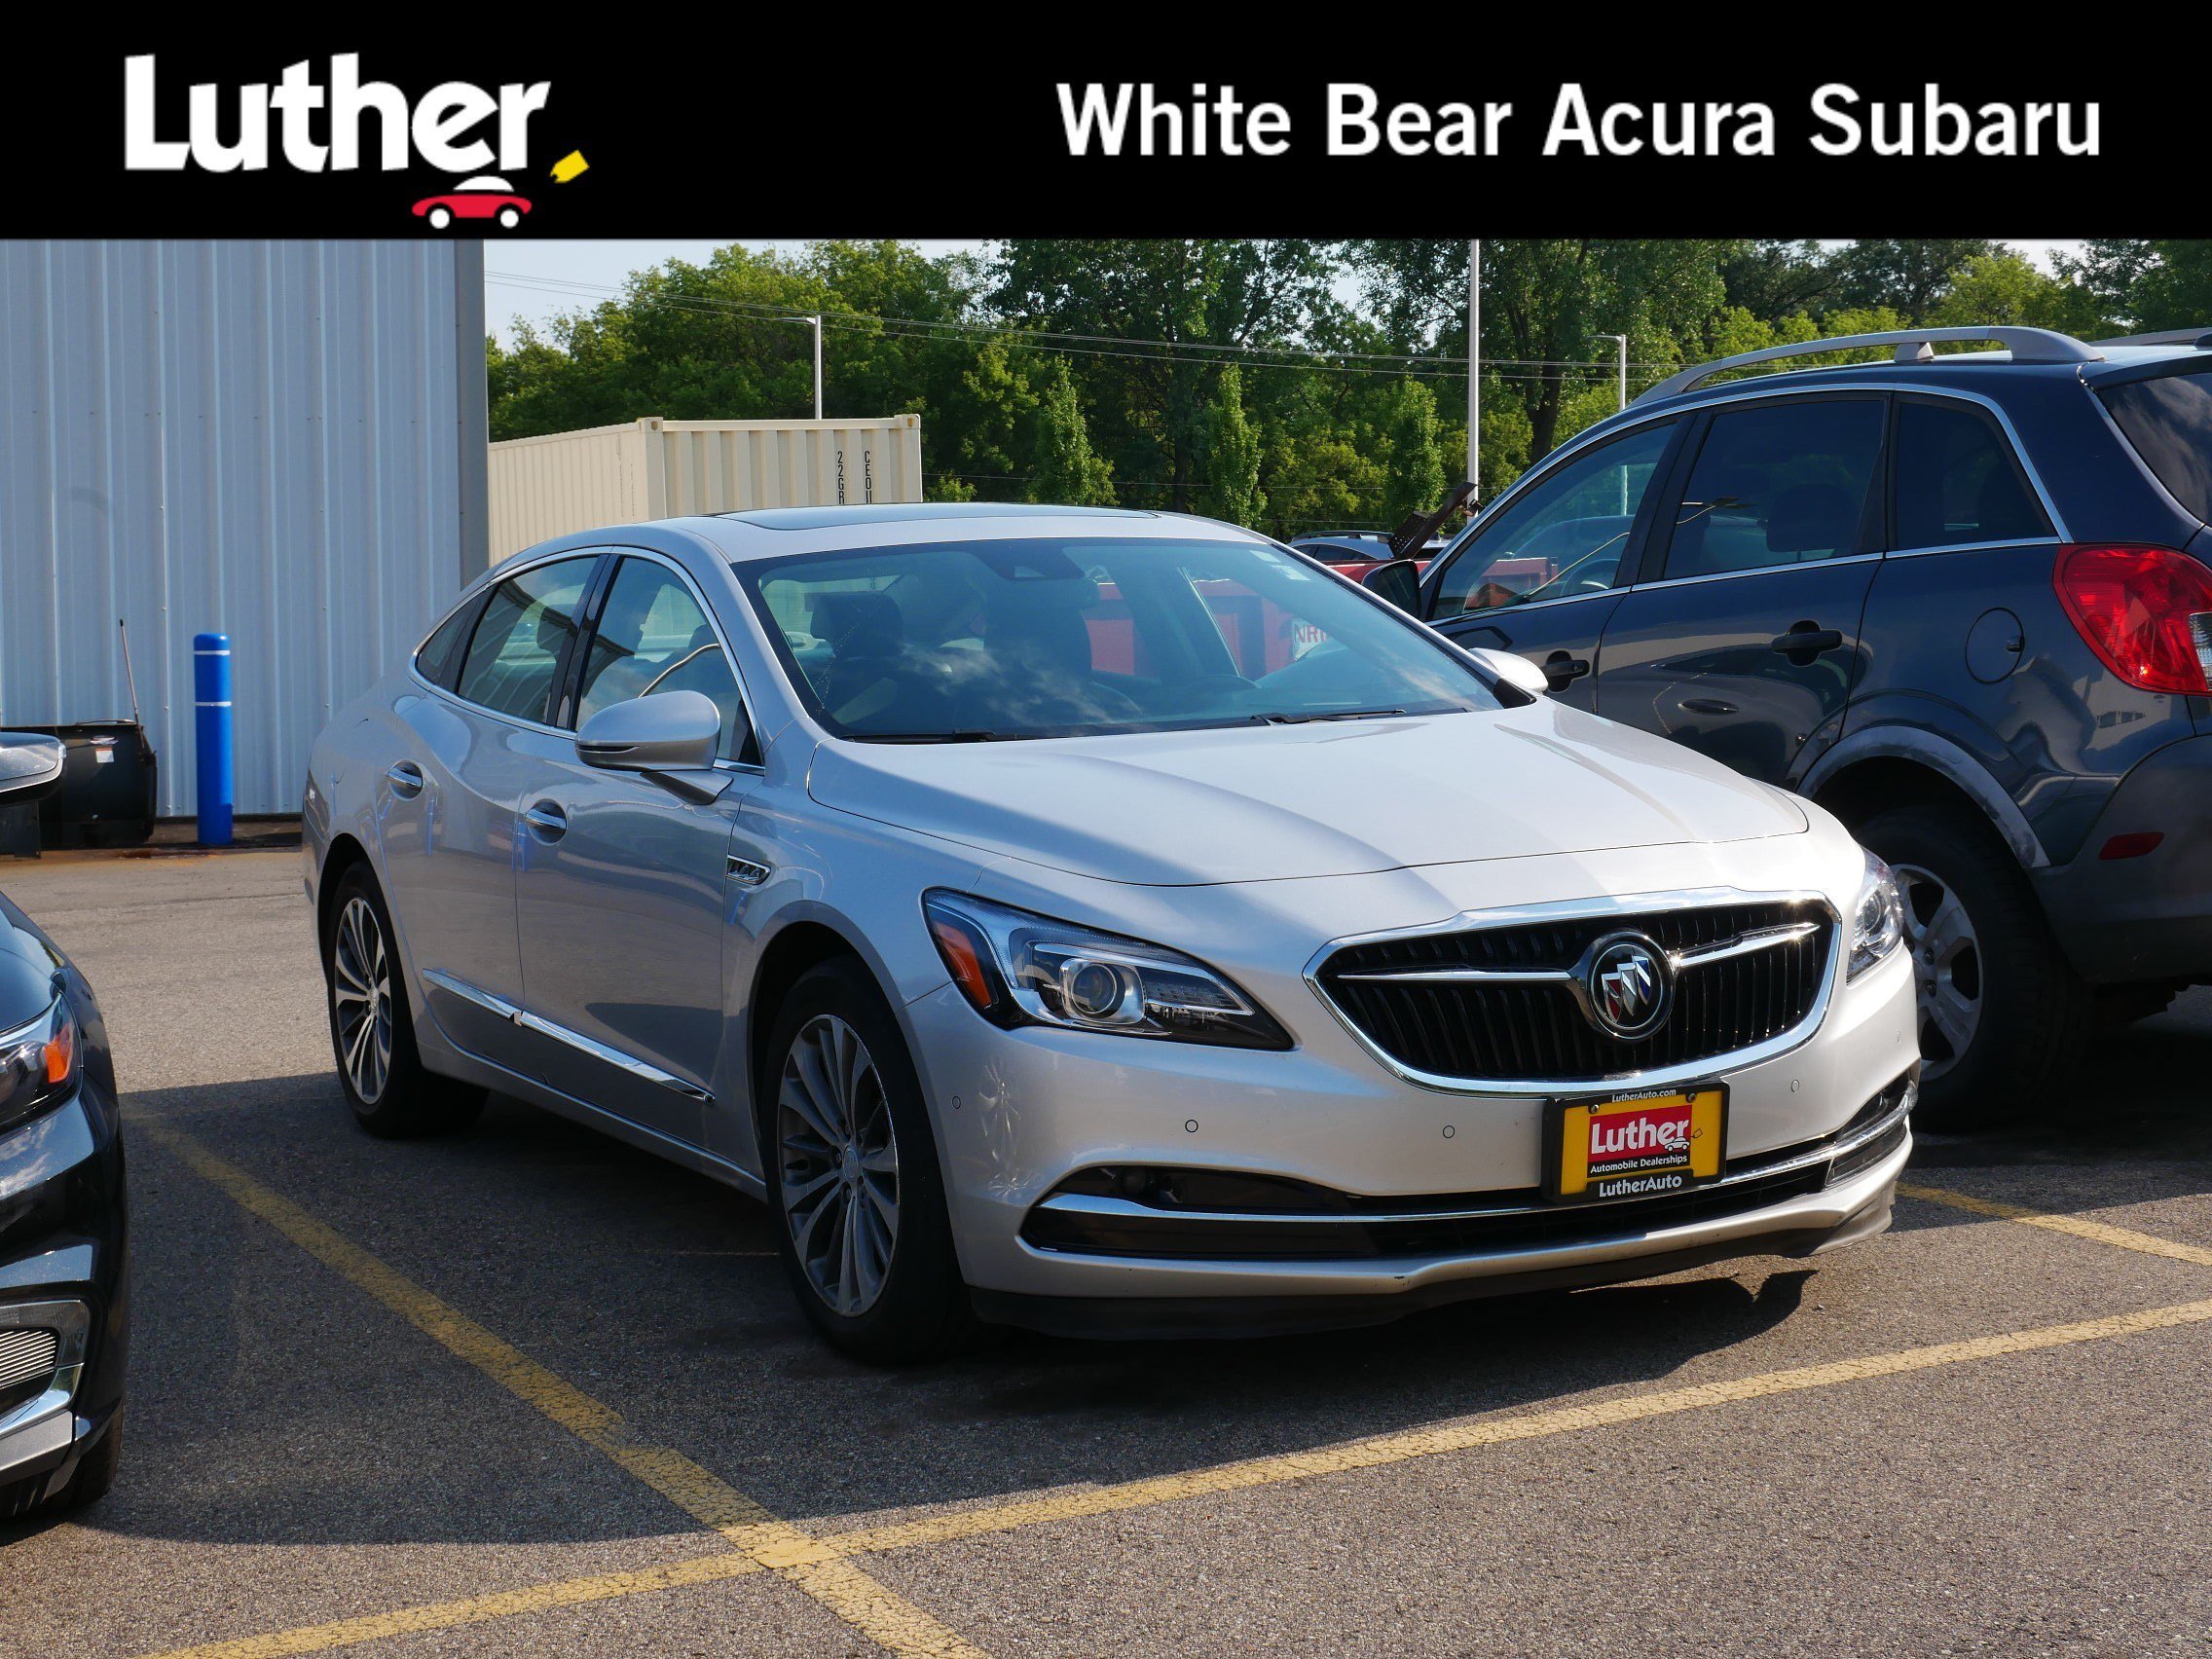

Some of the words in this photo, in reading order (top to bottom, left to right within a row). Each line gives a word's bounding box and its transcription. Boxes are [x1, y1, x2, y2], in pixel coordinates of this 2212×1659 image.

[1611, 1088, 1677, 1103] LutherAuto.com
[1590, 1117, 1690, 1155] Luther
[1590, 1159, 1639, 1174] Automobile
[1640, 1154, 1688, 1168] Dealerships
[1599, 1174, 1682, 1198] LutherAuto
